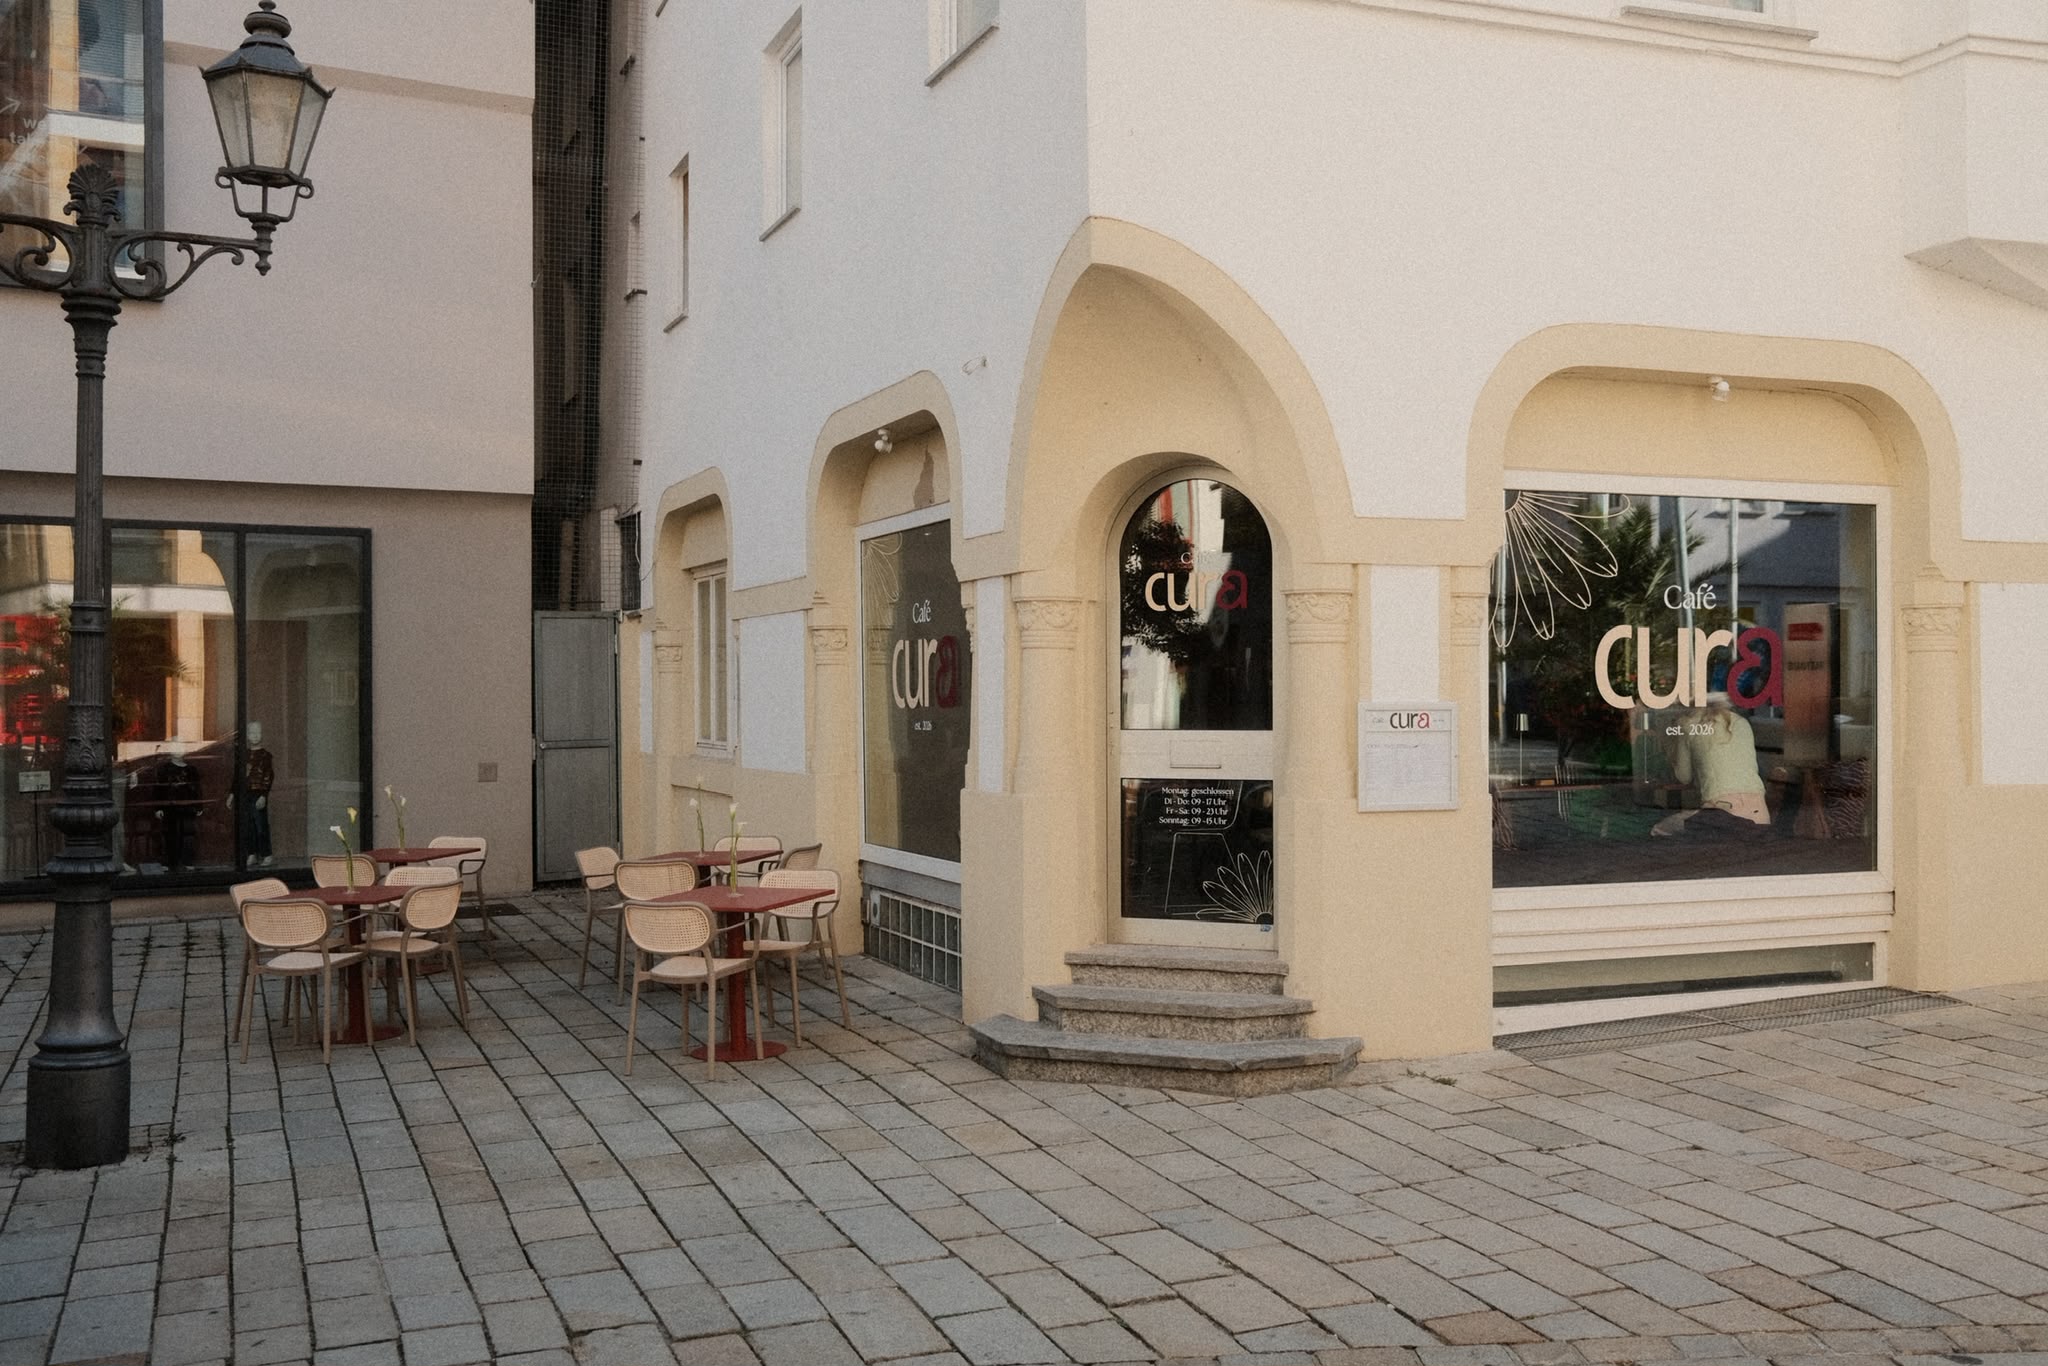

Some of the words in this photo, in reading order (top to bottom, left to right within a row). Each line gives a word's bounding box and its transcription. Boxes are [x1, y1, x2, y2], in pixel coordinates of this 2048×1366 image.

[1144, 569, 1249, 612] cura
[1663, 582, 1717, 610] Café
[912, 599, 932, 624] Café
[891, 634, 961, 710] cura
[1594, 624, 1784, 710] cura
[1389, 712, 1431, 729] cura
[1665, 725, 1685, 736] est.
[1688, 723, 1715, 736] 2026
[1161, 787, 1190, 798] Montag:
[1191, 787, 1234, 798] geschlossen
[1191, 798, 1201, 806] 09
[1213, 798, 1227, 806] Uhr
[1178, 807, 1190, 815] Sa:
[1215, 808, 1229, 816] Uhr
[1159, 816, 1190, 827] Sonntag:
[1191, 817, 1201, 825] 09
[1206, 817, 1213, 825] 15
[1213, 817, 1228, 825] Uhr
